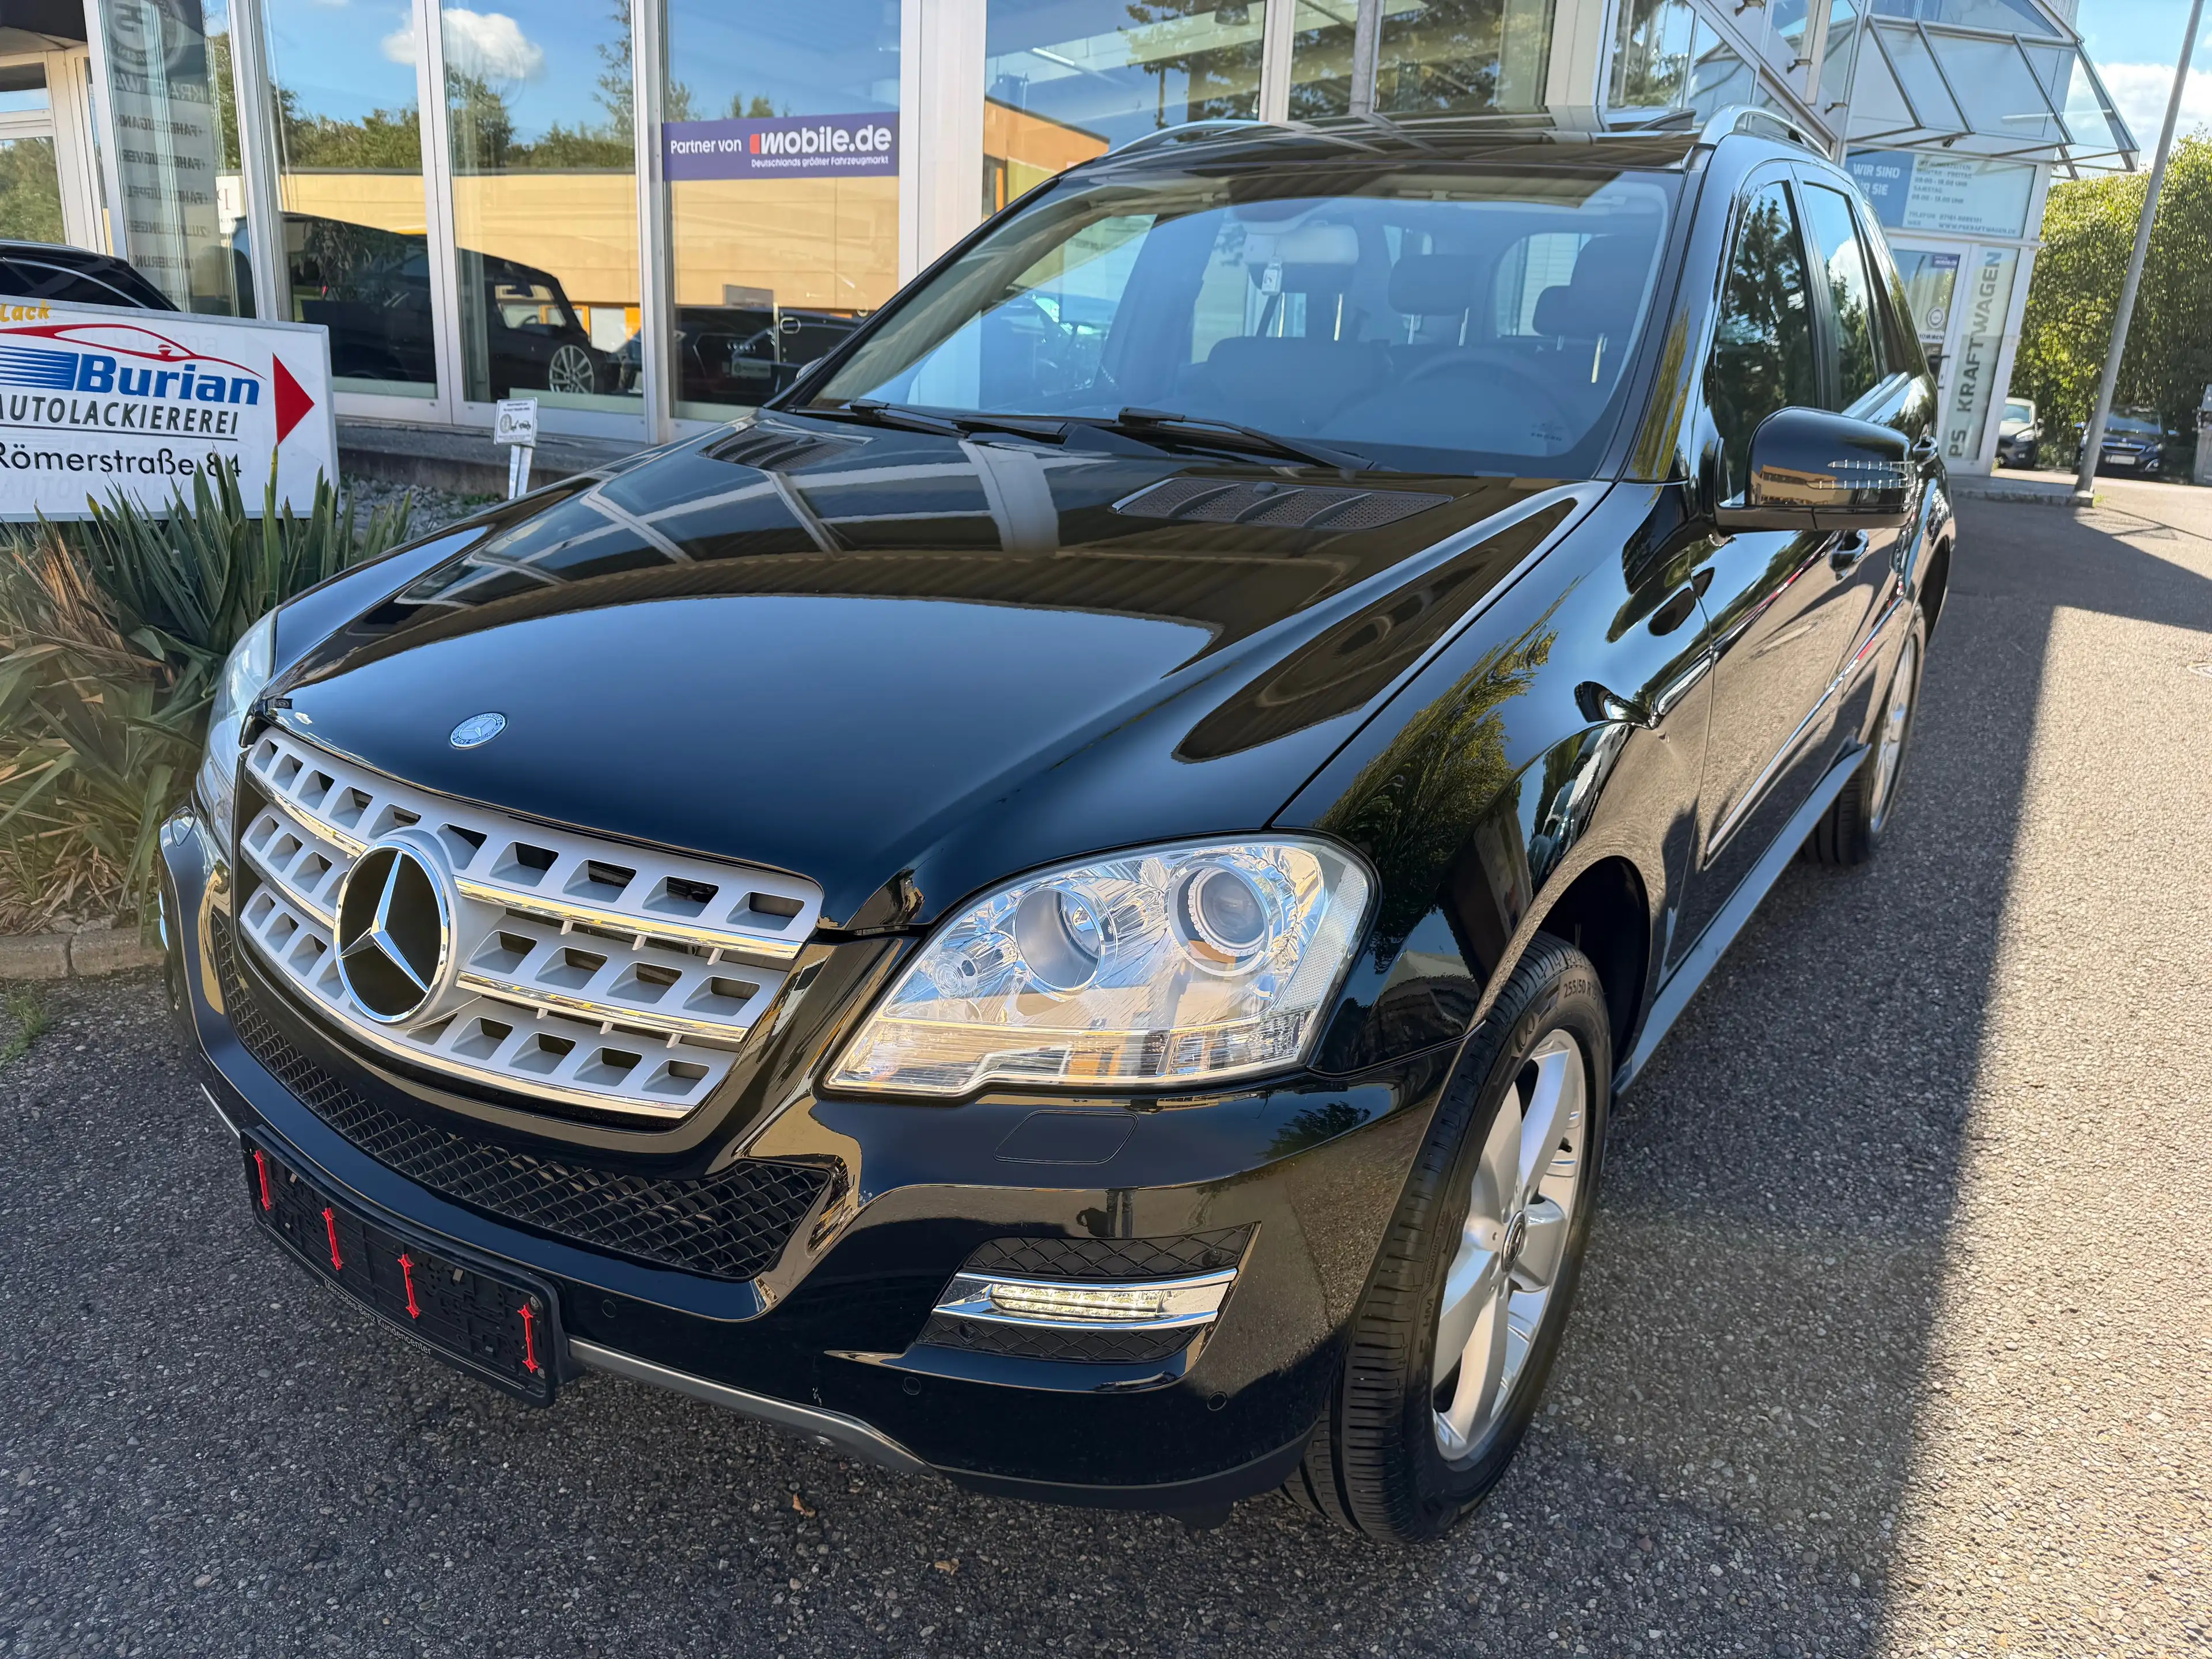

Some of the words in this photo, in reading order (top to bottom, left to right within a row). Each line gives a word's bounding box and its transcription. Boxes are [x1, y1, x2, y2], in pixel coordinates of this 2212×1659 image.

[671, 139, 715, 154] Partner
[718, 139, 742, 153] von
[761, 125, 892, 154] mobile.de
[751, 157, 801, 168] Deutschlands
[802, 157, 830, 169] größter
[831, 156, 889, 166] Fahrzeugmarkt
[1853, 163, 1874, 176] WIR
[1876, 165, 1900, 179] SIND
[1872, 182, 1889, 196] SIE
[1957, 251, 2002, 413] KRAFTWAGEN
[77, 354, 260, 405] Burian
[1948, 430, 1967, 458] PS
[1563, 978, 1586, 999] 255/50
[324, 1279, 377, 1324] Mercedes-Benz
[377, 1317, 431, 1355] Kundencenter
